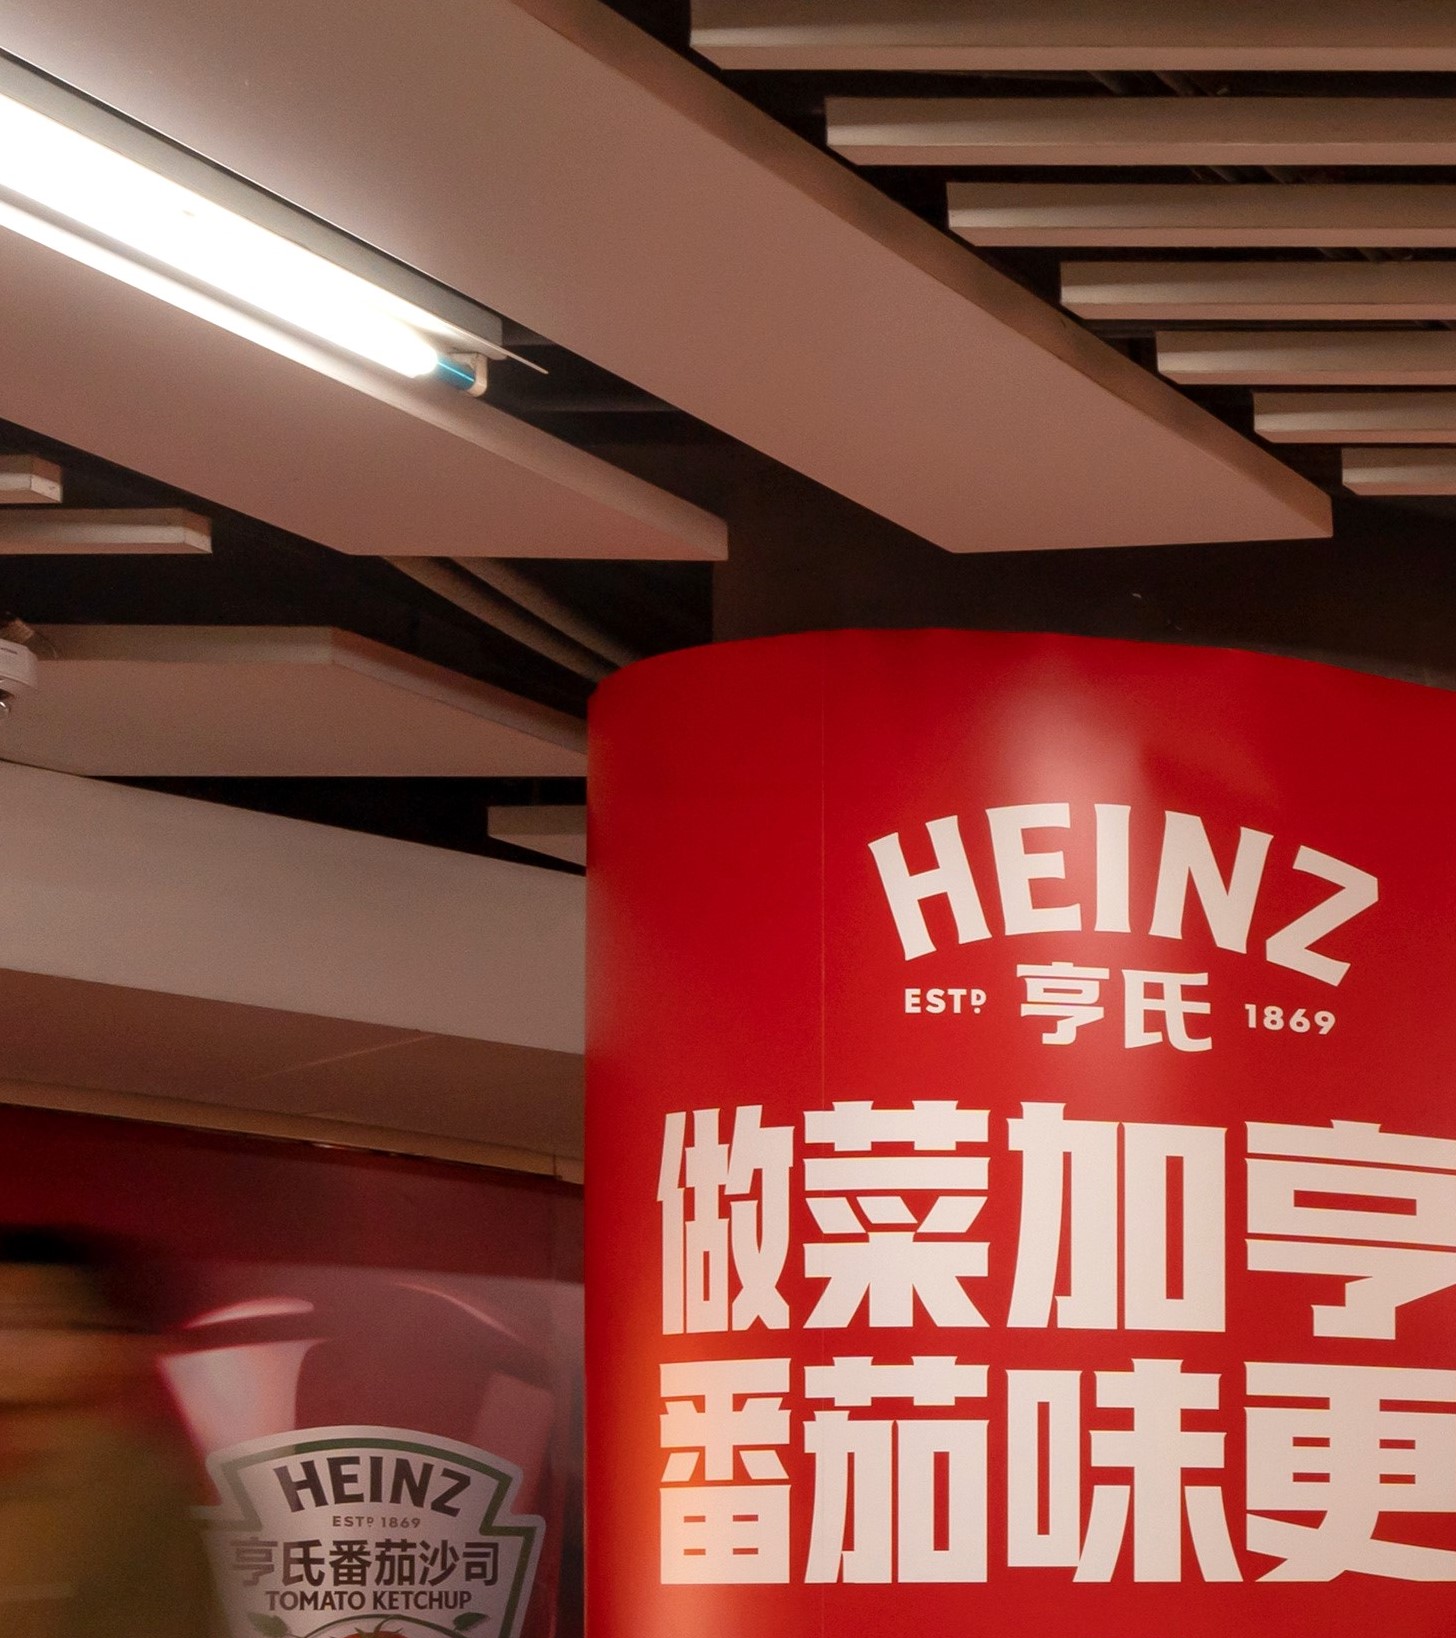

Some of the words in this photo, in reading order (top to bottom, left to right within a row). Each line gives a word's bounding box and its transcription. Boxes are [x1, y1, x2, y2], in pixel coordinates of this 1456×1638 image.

[867, 801, 1380, 986] HEINZ
[1016, 961, 1213, 1052] 亨氏
[1243, 1002, 1337, 1035] 1869
[273, 1455, 472, 1518] HEINZ
[380, 1516, 421, 1528] 1869
[229, 1536, 500, 1587] 亨氏番茄沙司
[265, 1590, 366, 1612] TOMATO
[371, 1590, 473, 1611] KETCHUP
